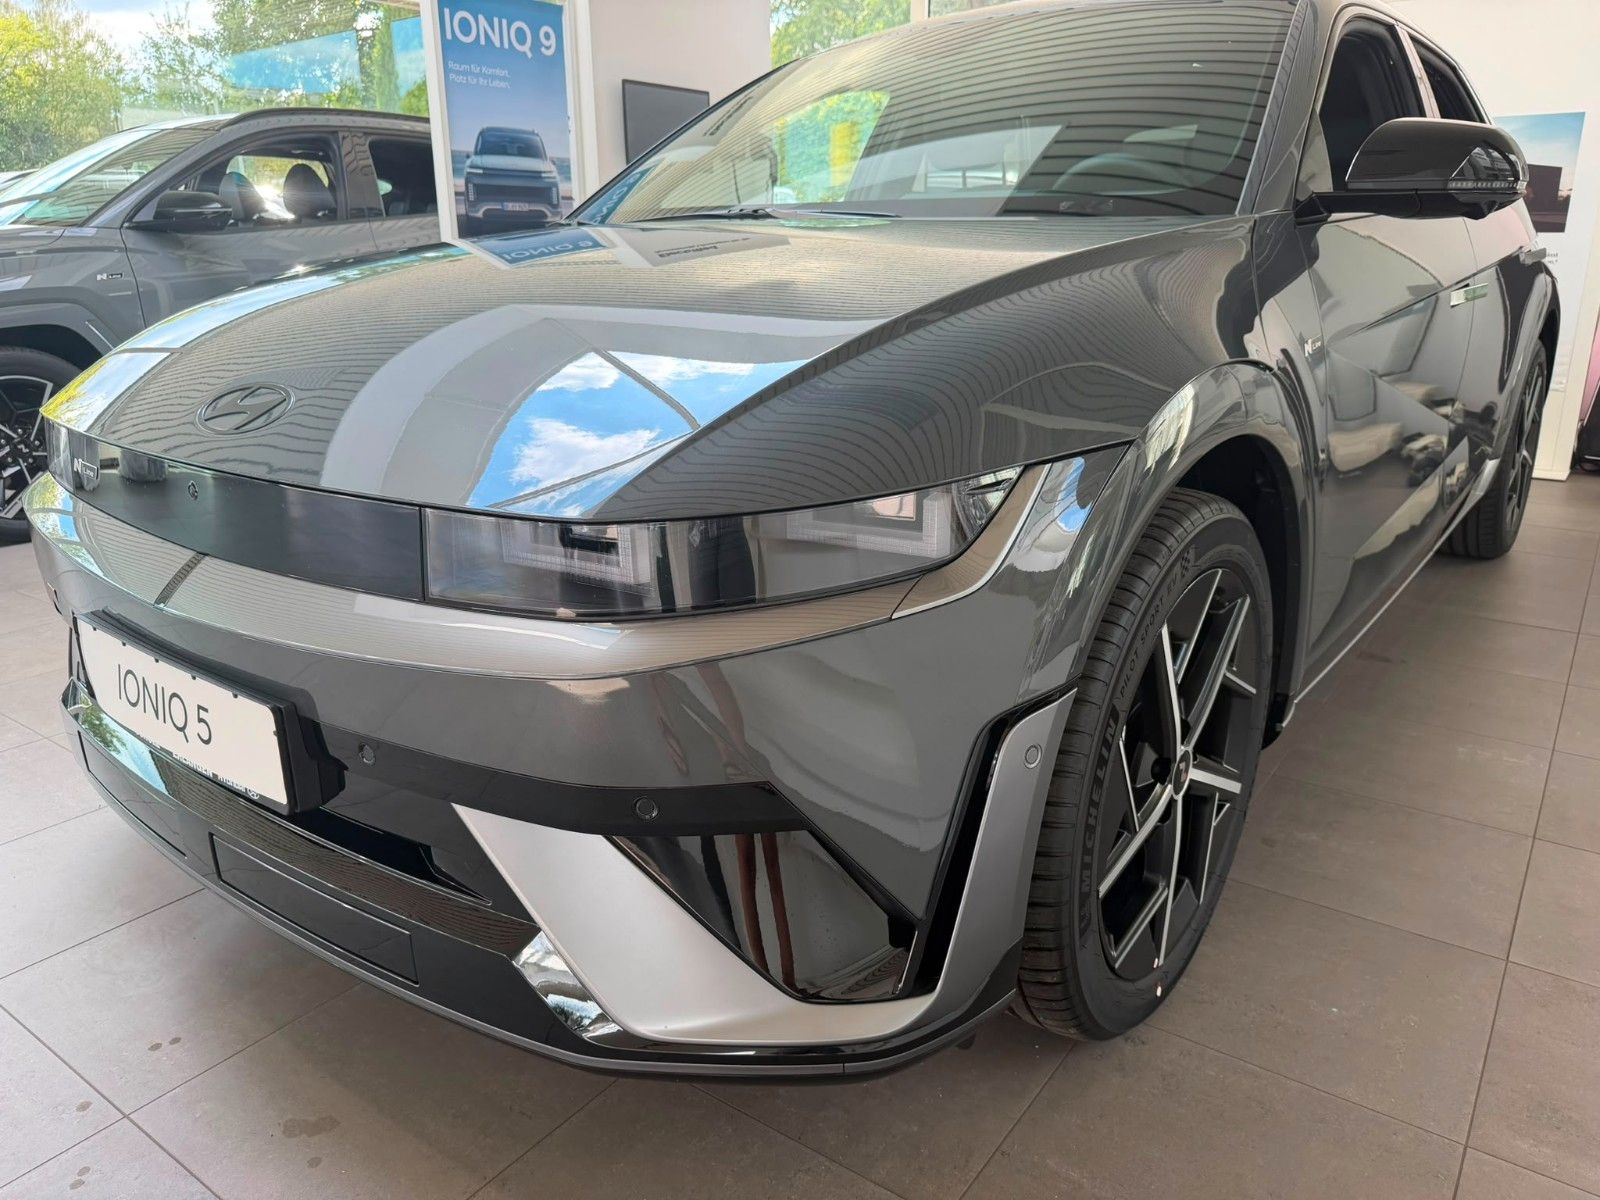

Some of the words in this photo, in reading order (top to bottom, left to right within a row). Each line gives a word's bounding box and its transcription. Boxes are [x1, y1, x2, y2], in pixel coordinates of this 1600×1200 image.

[444, 7, 533, 59] IONIQ
[539, 25, 557, 56] 9
[448, 60, 470, 72] Raum
[470, 64, 481, 74] für
[448, 73, 467, 84] Platz
[467, 76, 478, 85] für
[73, 457, 82, 474] N
[1120, 650, 1139, 698] PILOT
[1141, 597, 1164, 645] SPORT
[118, 664, 189, 743] IONIQ
[197, 704, 212, 745] 5
[1081, 721, 1117, 894] MICHELIN
